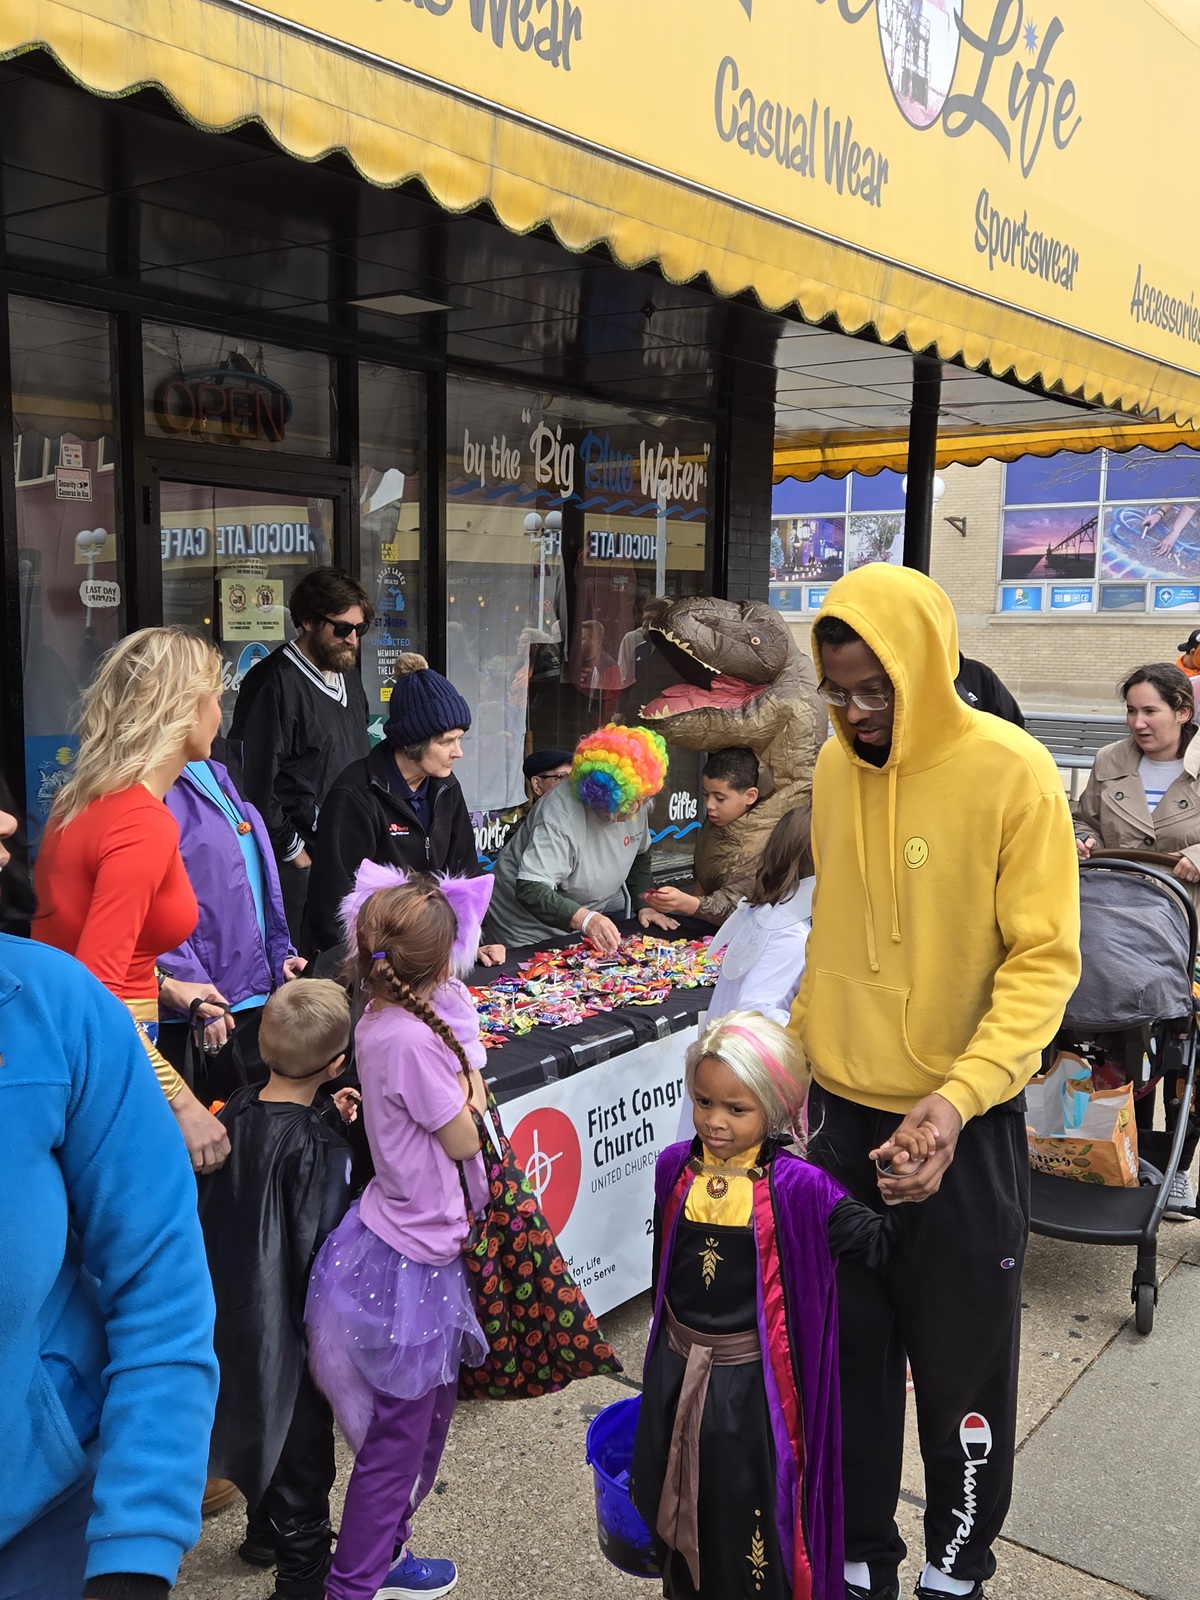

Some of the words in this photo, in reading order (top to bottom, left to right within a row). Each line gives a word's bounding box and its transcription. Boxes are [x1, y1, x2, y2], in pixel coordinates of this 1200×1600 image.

[942, 0, 1082, 180] Life
[714, 55, 819, 179] Casual
[823, 105, 889, 208] Wear
[974, 187, 1079, 292] Sportswear
[163, 380, 285, 442] OPEN
[58, 479, 76, 490] Security
[463, 428, 486, 488] by
[490, 434, 521, 480] the
[579, 429, 634, 494] Blue
[86, 585, 102, 594] LAST
[103, 587, 117, 596] DAY
[377, 567, 391, 584] GREAT
[392, 567, 406, 585] LAKES
[669, 790, 698, 821] Gifts
[587, 1097, 627, 1139] First
[631, 1078, 683, 1117] Congr
[593, 1117, 655, 1168] Church
[591, 1167, 622, 1194] UNITED
[572, 1265, 585, 1278] for
[586, 1256, 602, 1271] Life
[583, 1277, 592, 1288] to
[593, 1263, 617, 1282] Serve
[939, 1411, 993, 1575] Champion
